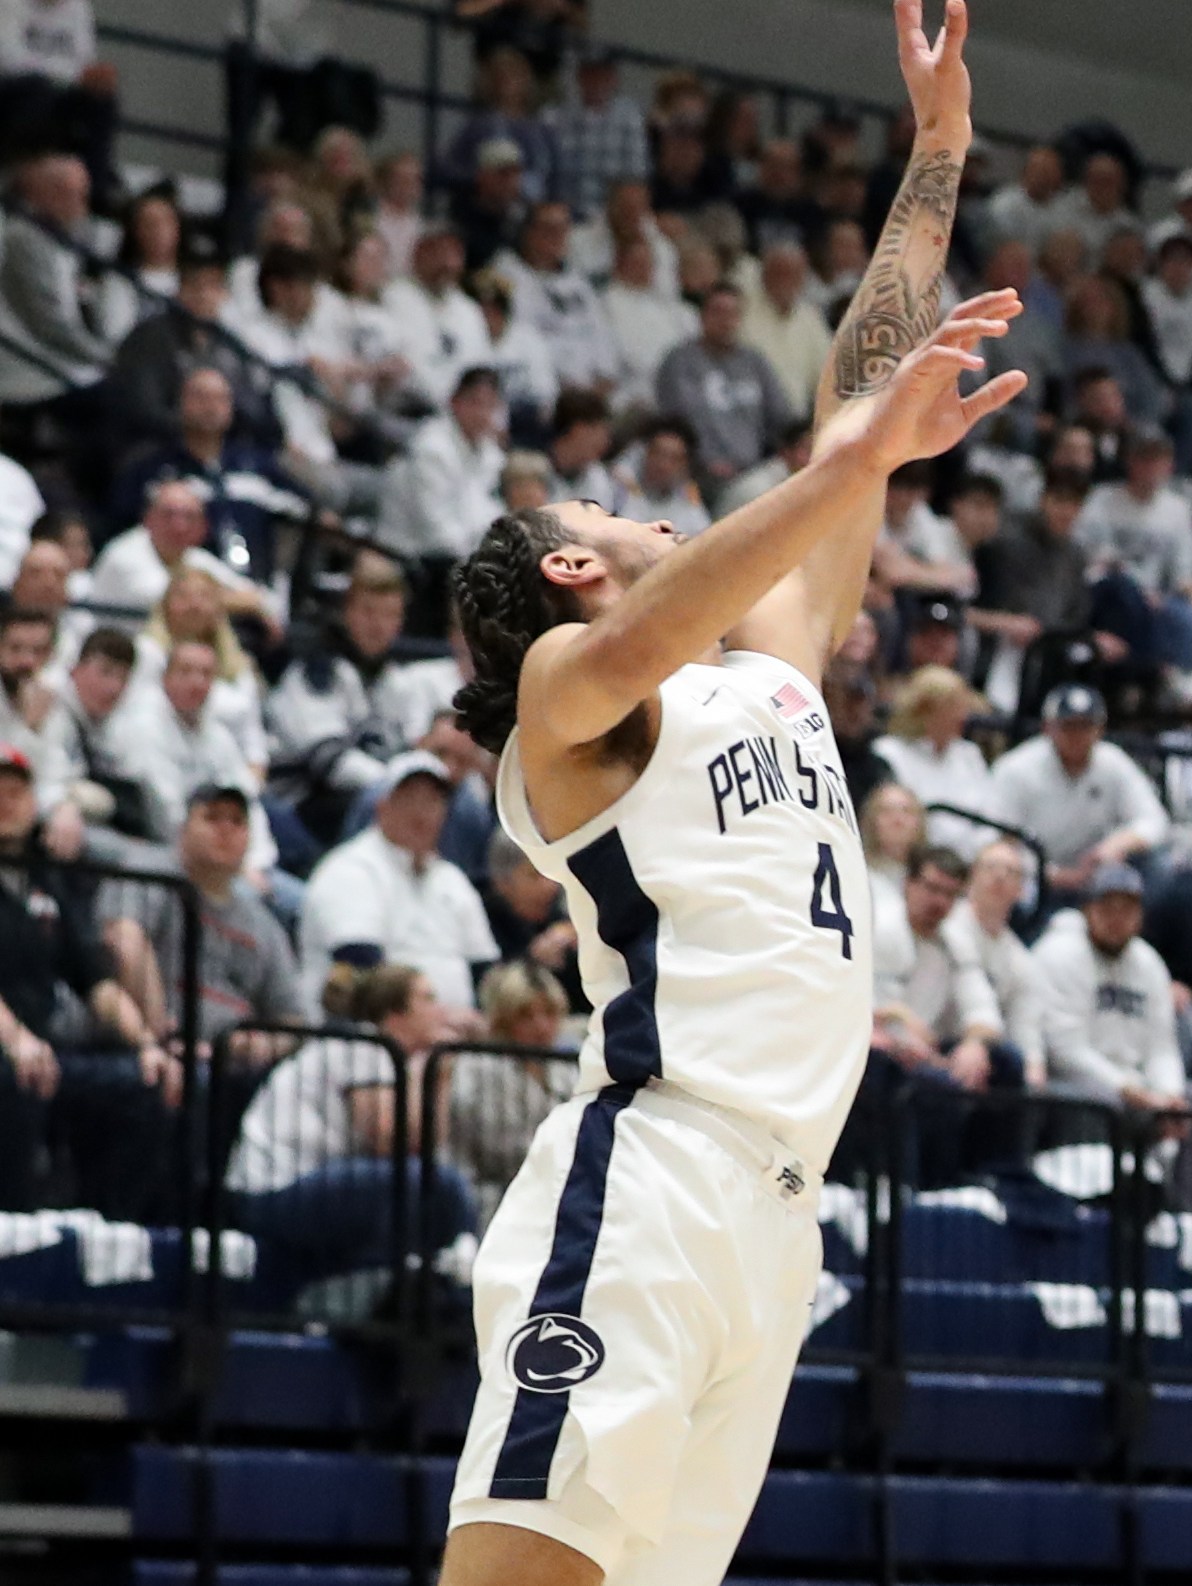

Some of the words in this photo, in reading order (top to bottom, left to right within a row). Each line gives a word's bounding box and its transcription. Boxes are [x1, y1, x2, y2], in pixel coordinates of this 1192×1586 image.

[707, 736, 795, 836] PENN
[792, 739, 858, 837] STA
[810, 841, 854, 961] 4
